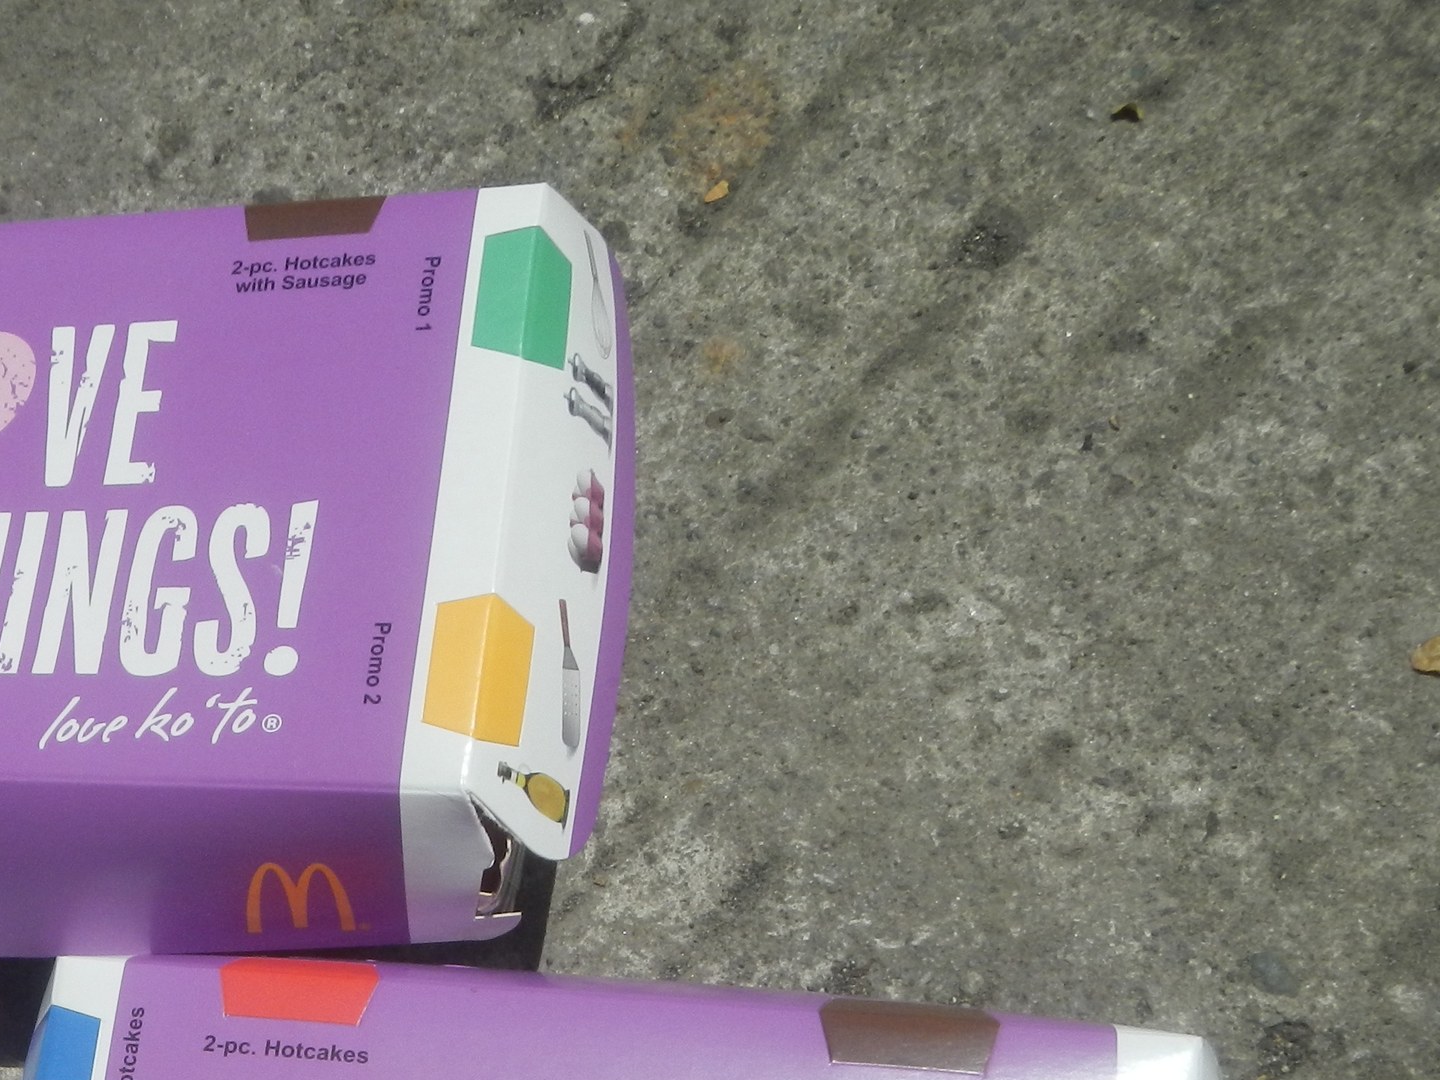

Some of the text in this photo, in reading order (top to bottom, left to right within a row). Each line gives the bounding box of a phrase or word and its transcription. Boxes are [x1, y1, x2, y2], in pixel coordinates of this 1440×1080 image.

[231, 251, 377, 277] 2-pc. Hotcakes
[235, 271, 367, 294] with Sausage
[418, 256, 442, 317] Promo
[363, 622, 393, 705] Promo 2
[39, 696, 128, 749] love
[136, 688, 195, 741] ko
[203, 1035, 369, 1065] 2-pc. Hotcakes
